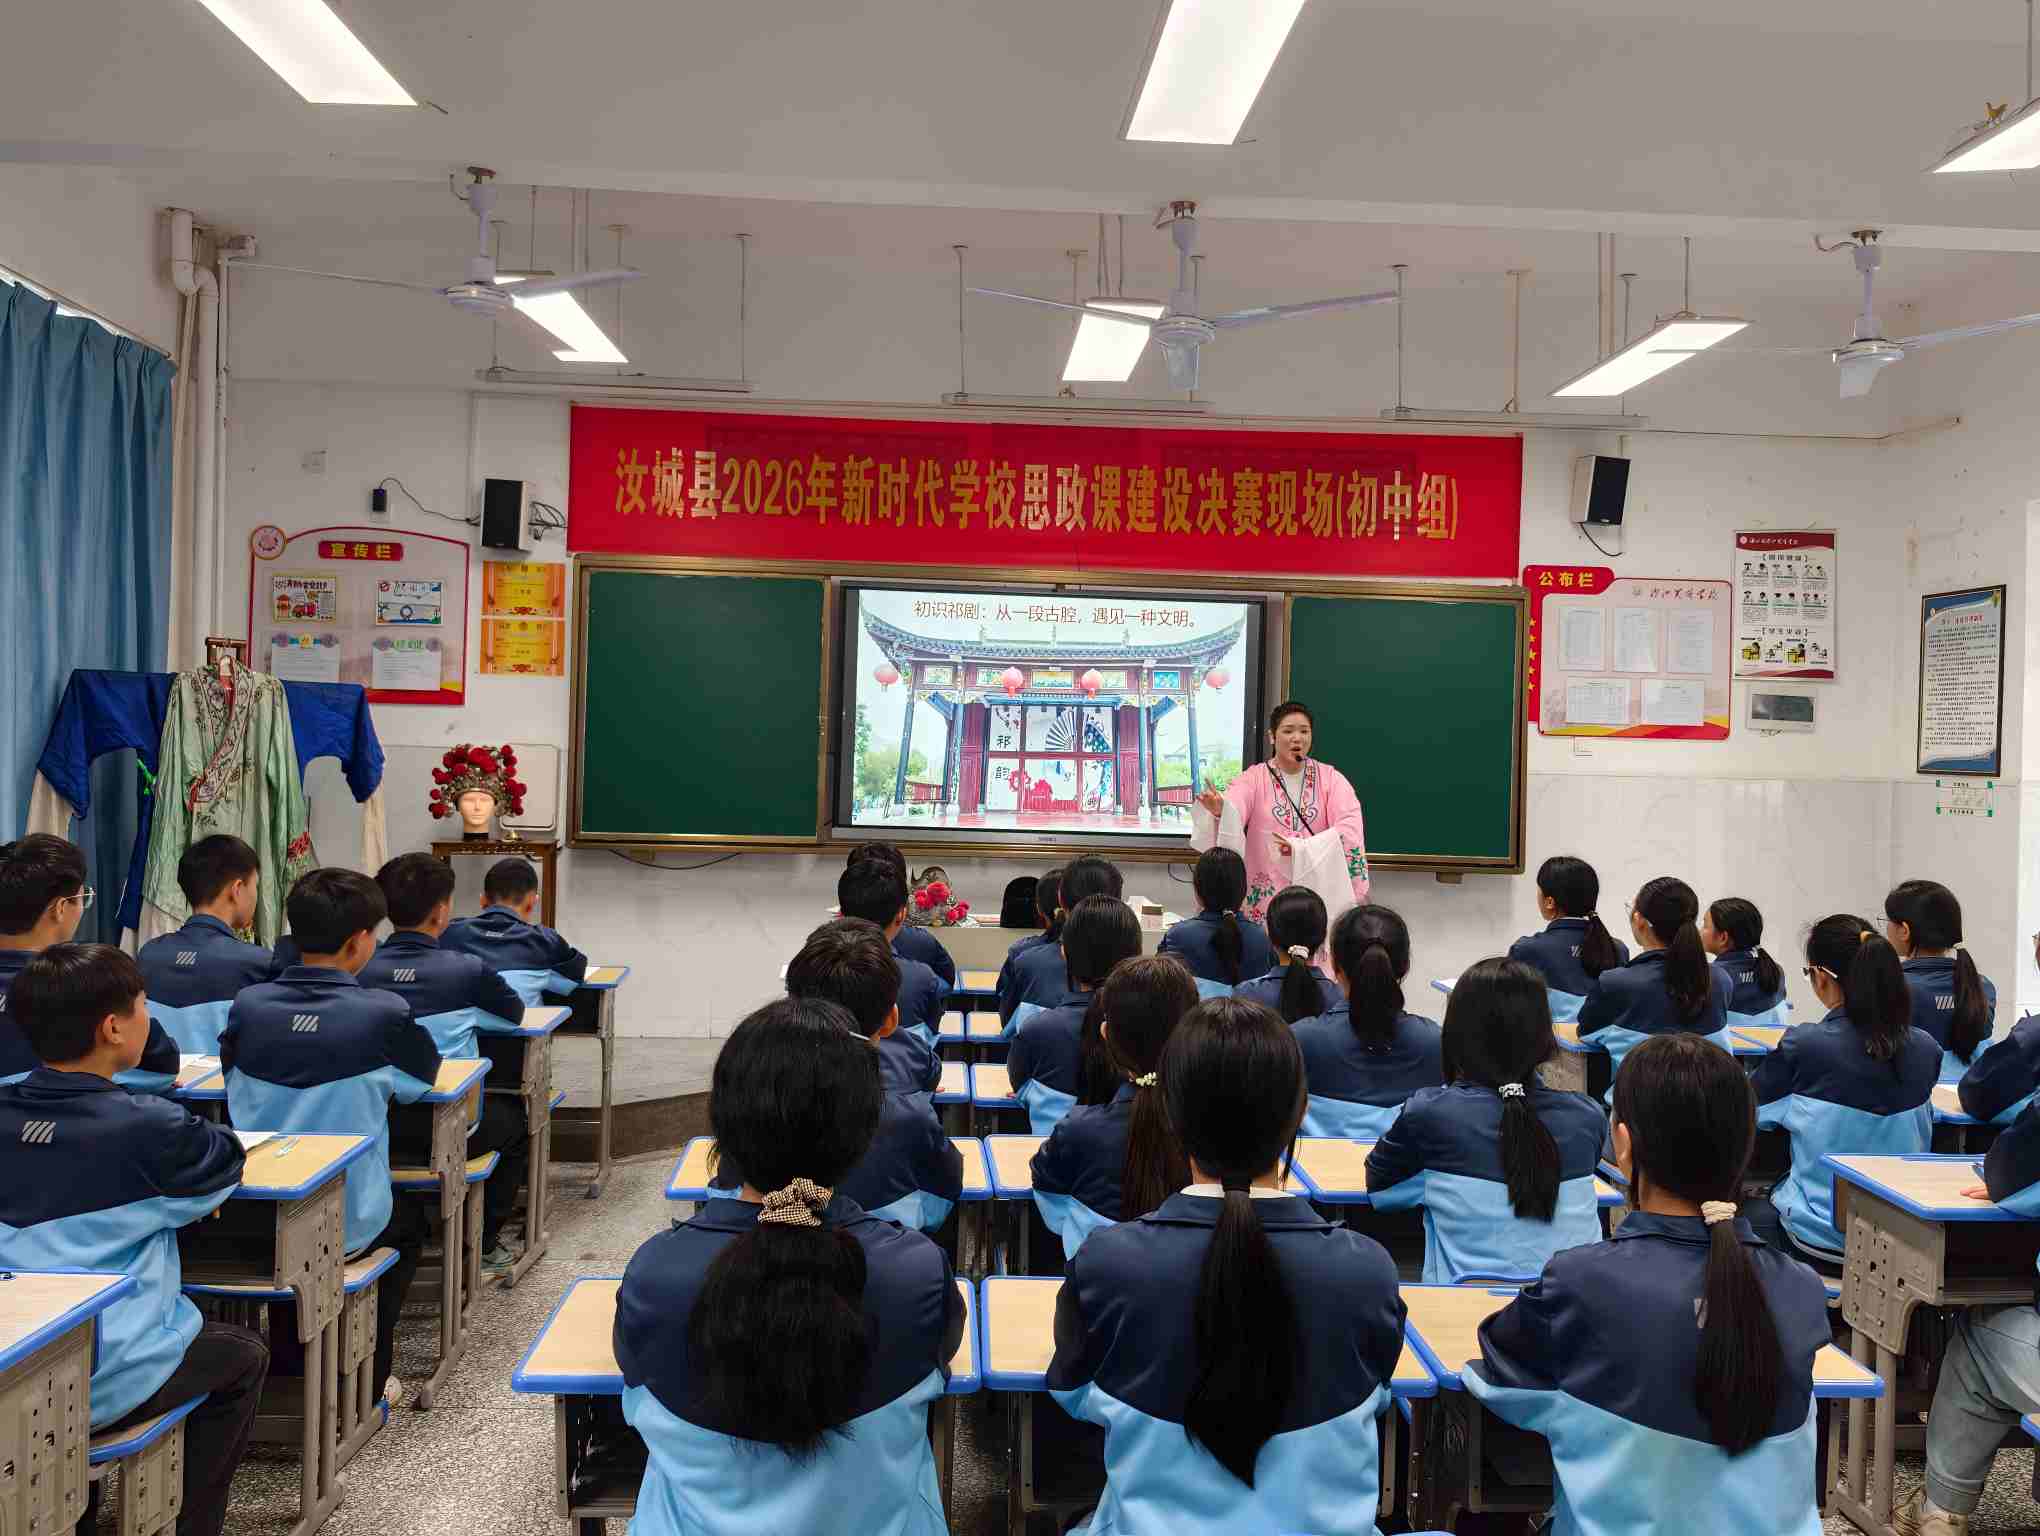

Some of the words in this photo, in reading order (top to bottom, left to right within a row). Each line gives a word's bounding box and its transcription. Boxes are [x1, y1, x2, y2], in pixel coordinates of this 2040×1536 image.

[614, 447, 1457, 541] 汝城县2026年新时代学校思政课建设决赛现场(初中组)
[331, 543, 392, 559] 宣传栏
[1538, 571, 1594, 588] 公布栏
[912, 599, 1197, 628] 初识祁剧：从一段古腔，遇见一种文明。
